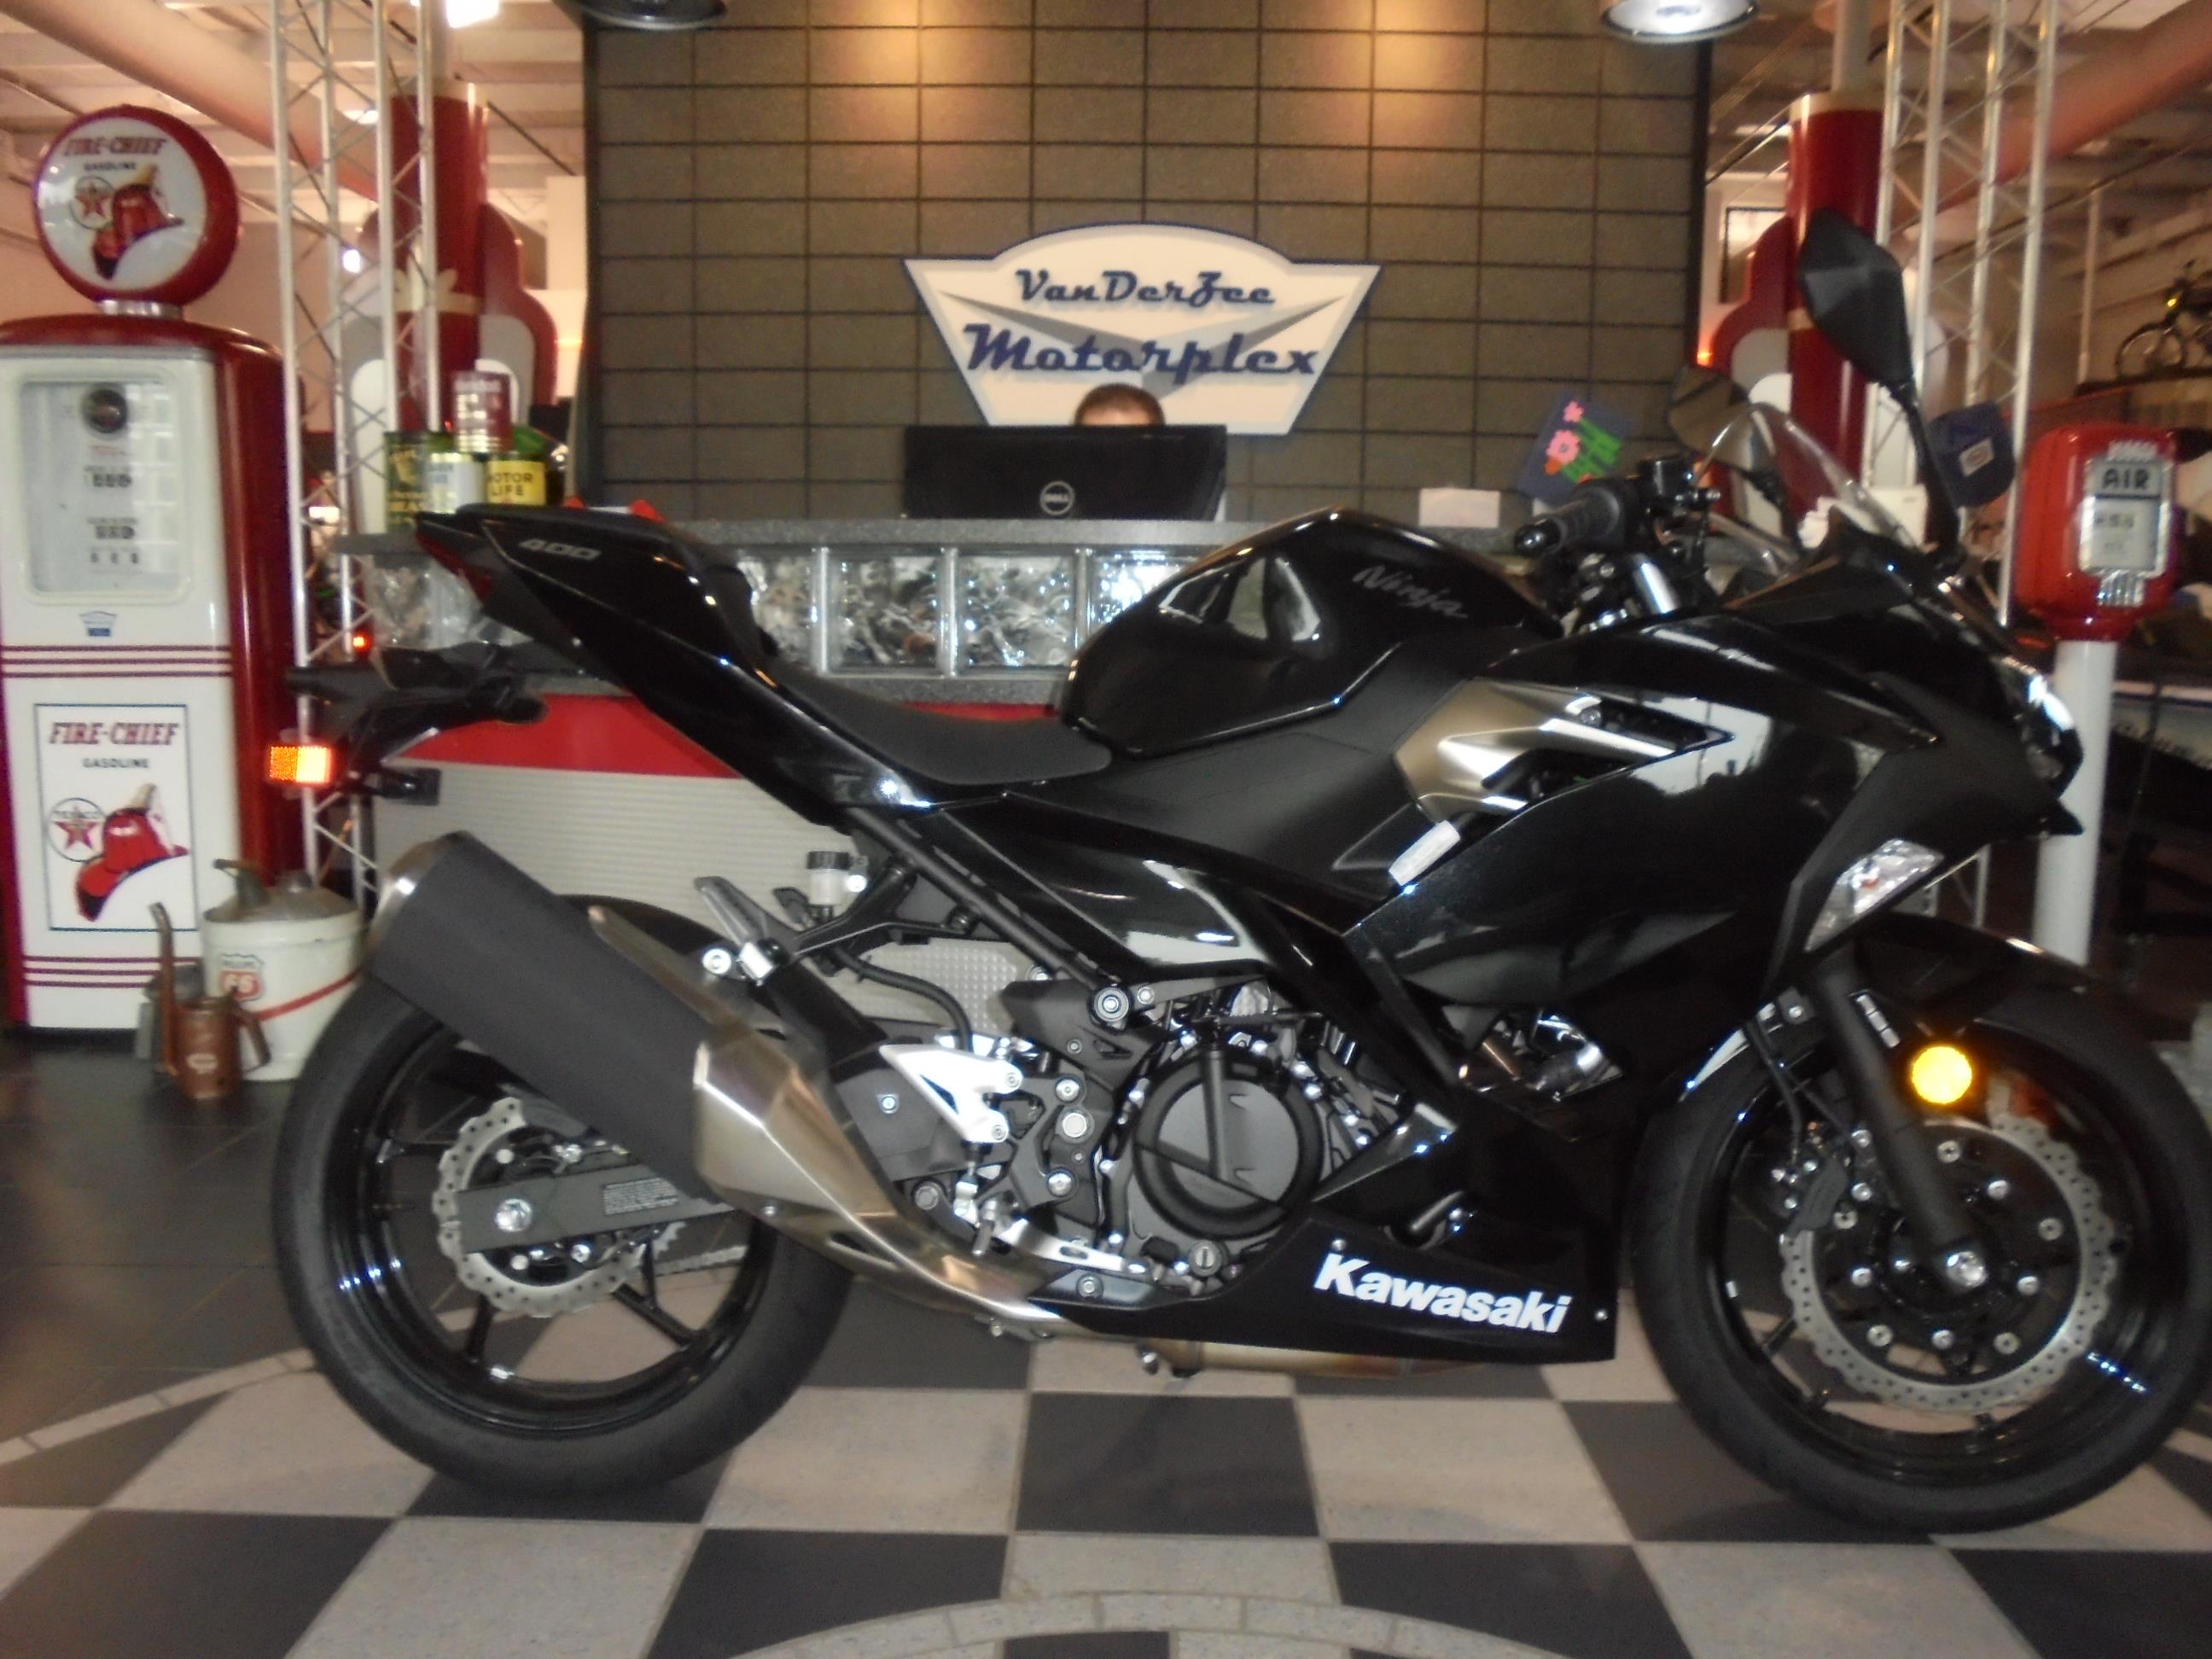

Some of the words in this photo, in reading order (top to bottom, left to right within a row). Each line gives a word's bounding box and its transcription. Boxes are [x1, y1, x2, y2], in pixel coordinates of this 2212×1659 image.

[1016, 269, 1276, 308] VanDerZee
[963, 323, 1319, 386] Motorplex
[491, 484, 524, 497] LIFE
[2102, 469, 2151, 489] AIR
[518, 538, 602, 561] 400
[1352, 565, 1468, 619] Ninja
[49, 722, 179, 746] FIRE-CHIEF
[82, 758, 149, 768] GASOLINE
[1314, 1252, 1573, 1333] Kawasaki
